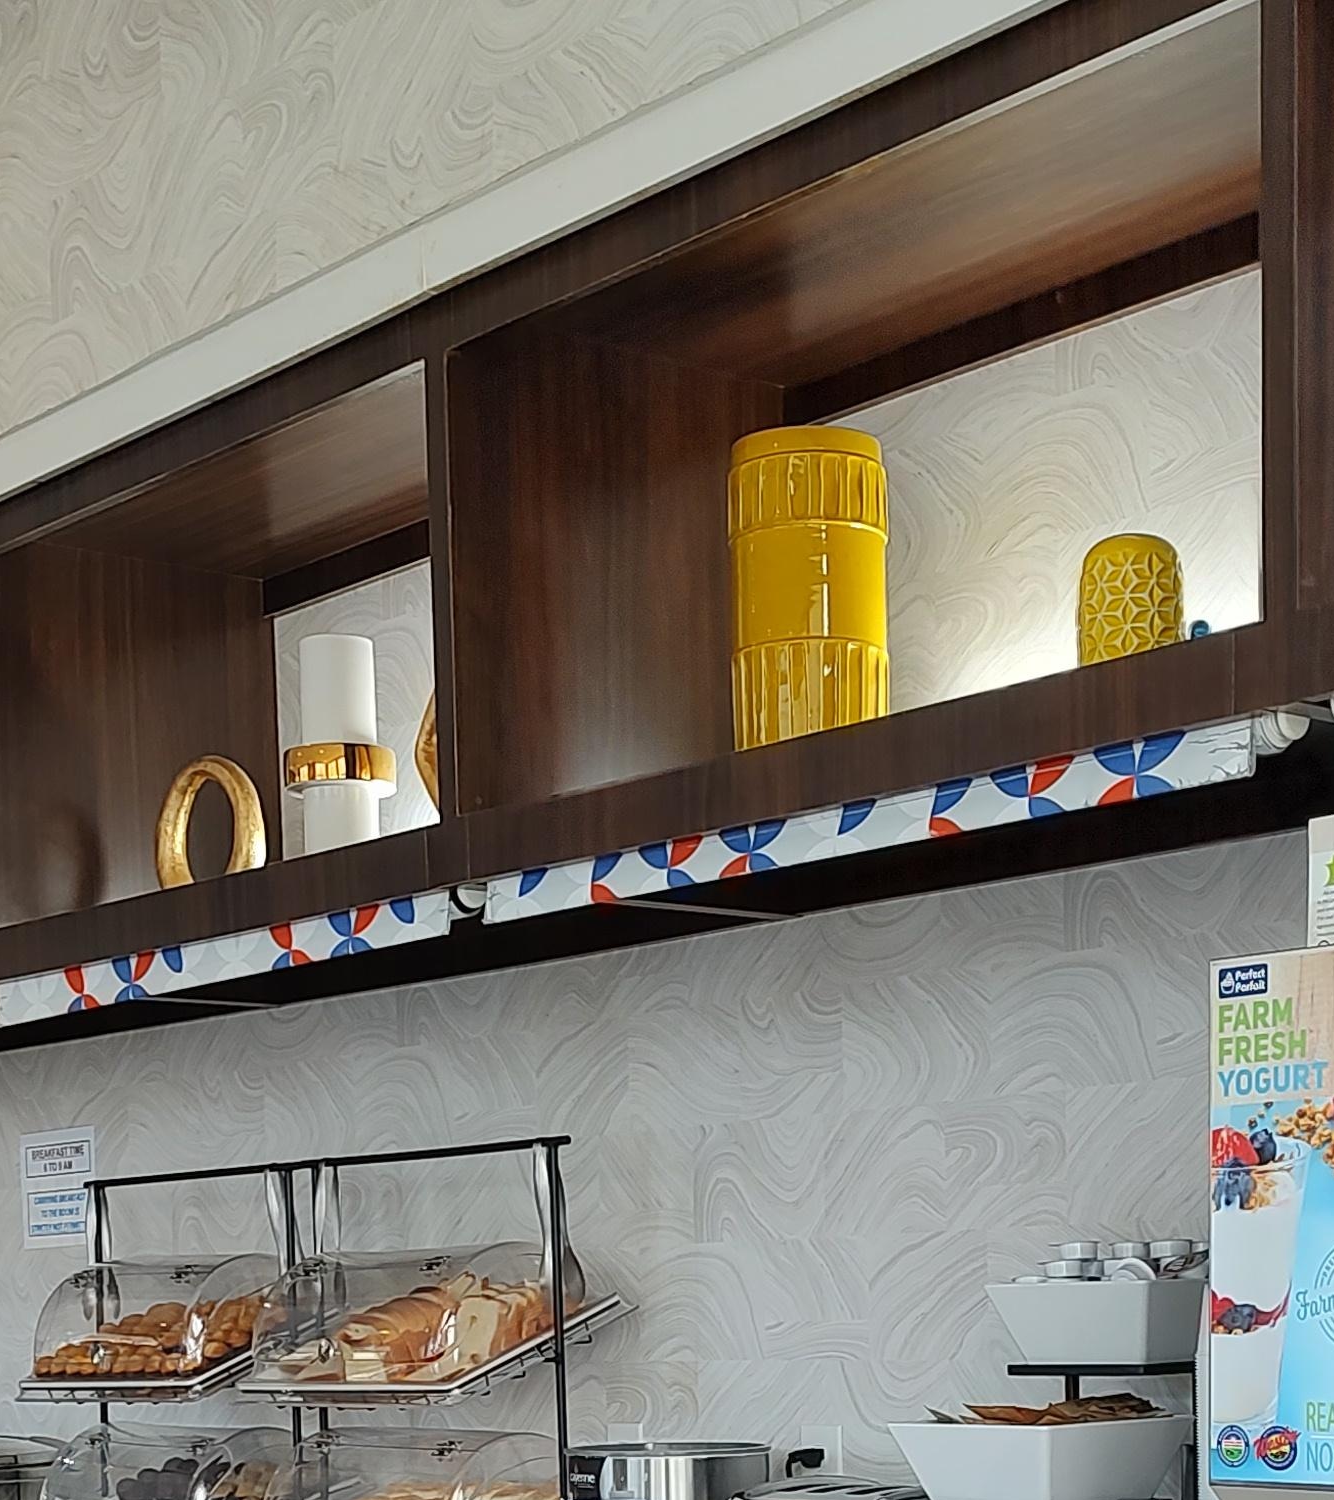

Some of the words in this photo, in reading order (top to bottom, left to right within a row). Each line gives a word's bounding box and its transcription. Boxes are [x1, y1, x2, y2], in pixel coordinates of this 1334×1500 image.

[1235, 968, 1266, 981] Perfect
[1218, 997, 1293, 1033] FARM
[1218, 1029, 1306, 1066] FRESH
[1218, 1061, 1328, 1097] YOGURT
[31, 1145, 68, 1160] BREAKFAST
[1307, 1442, 1333, 1472] NO
